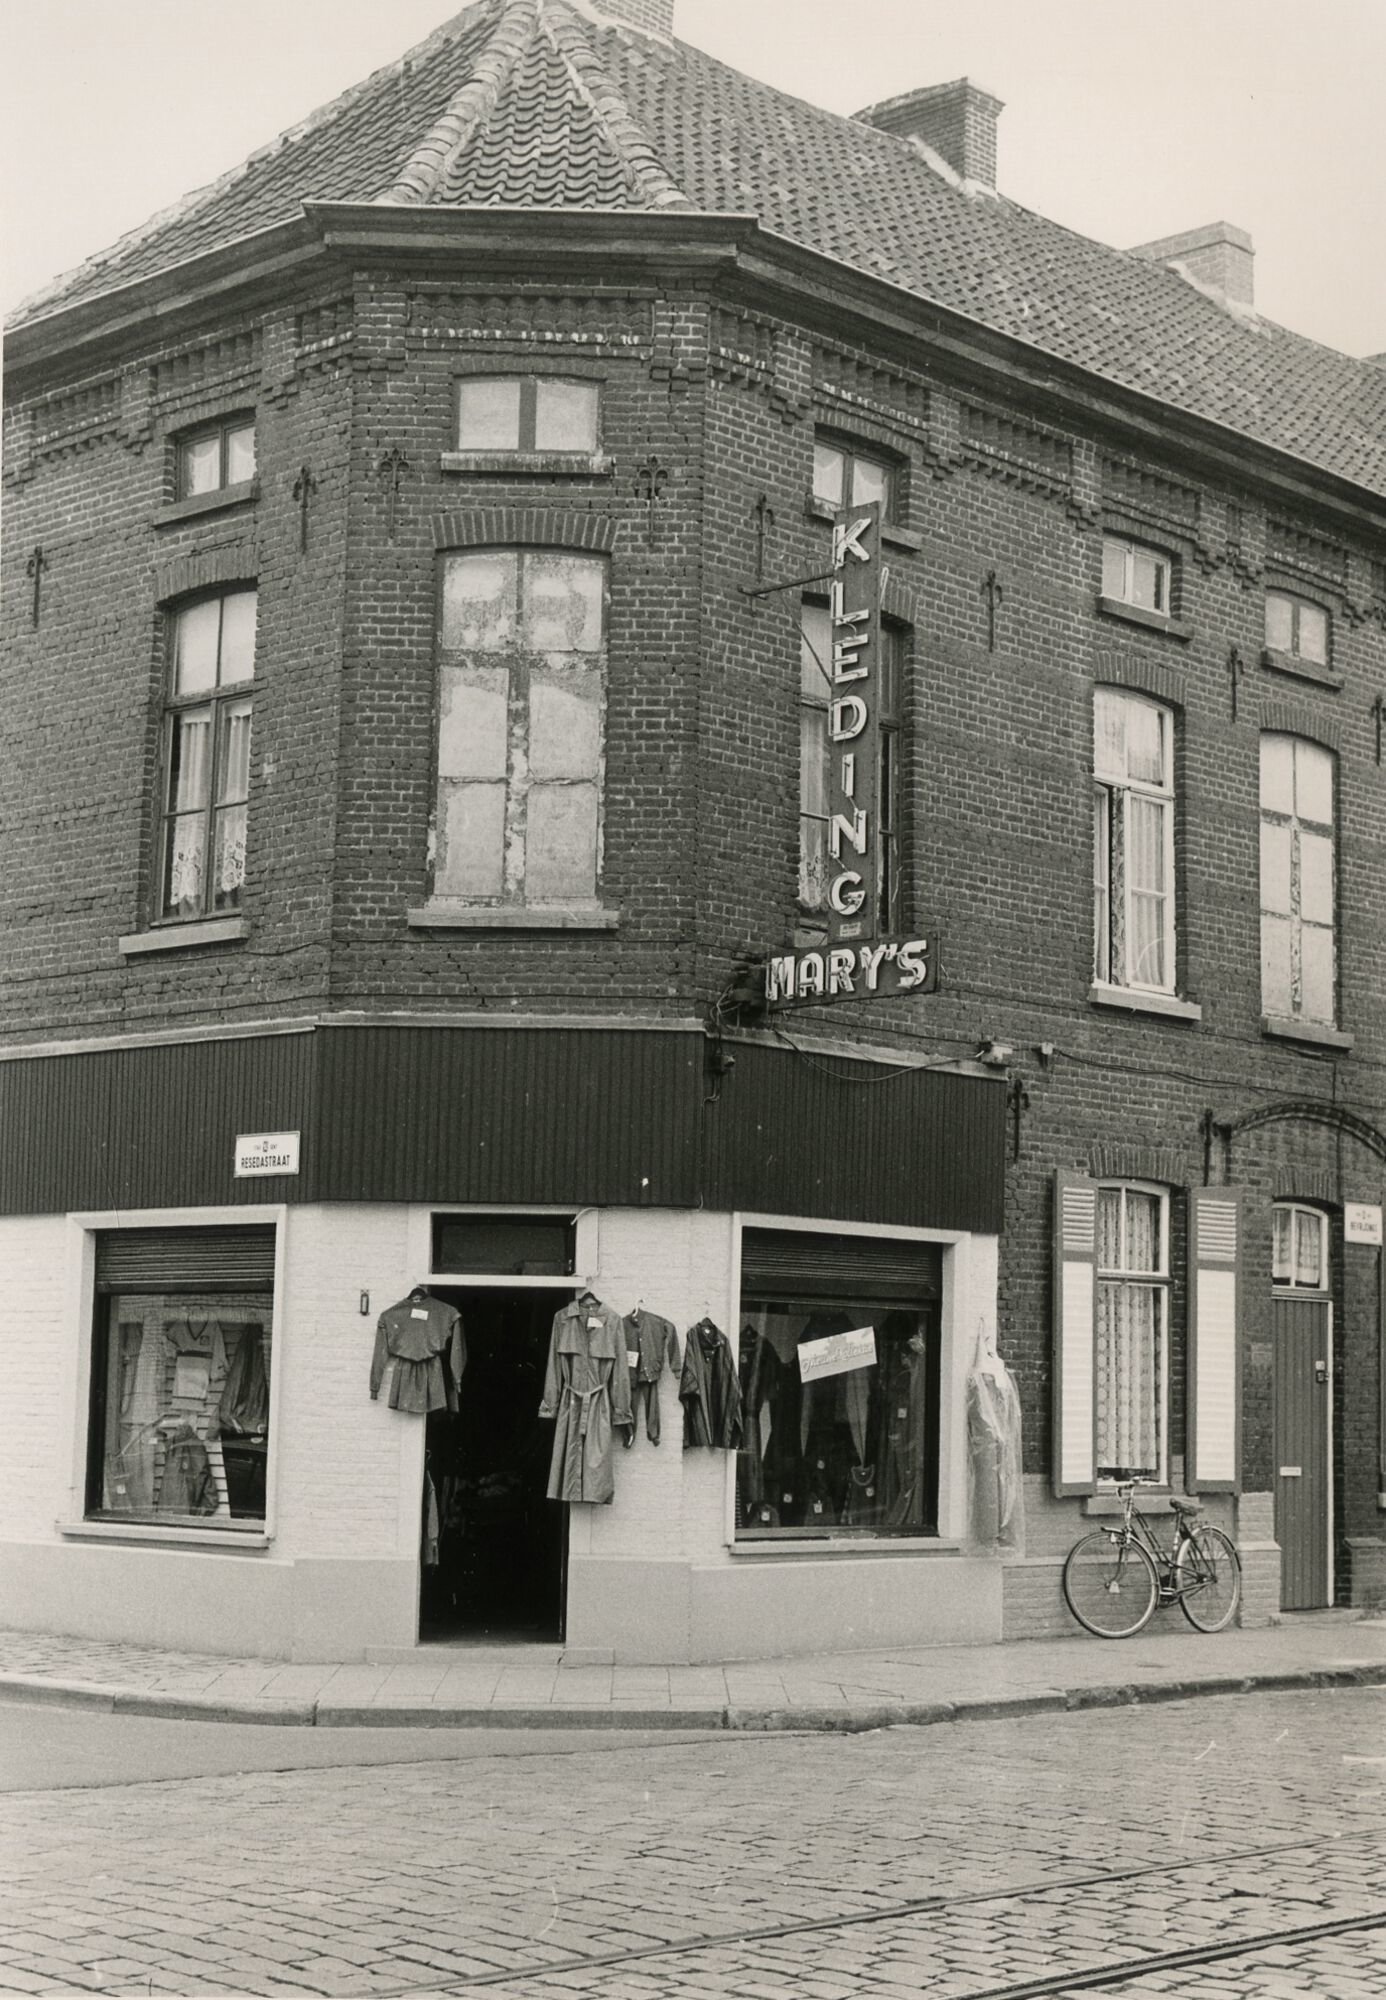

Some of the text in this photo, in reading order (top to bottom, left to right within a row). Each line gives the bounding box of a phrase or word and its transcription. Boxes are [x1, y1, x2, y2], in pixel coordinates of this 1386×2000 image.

[829, 518, 871, 915] KLEDING
[767, 940, 928, 1001] MARY'S
[241, 1154, 290, 1169] RESEDASTRAAT
